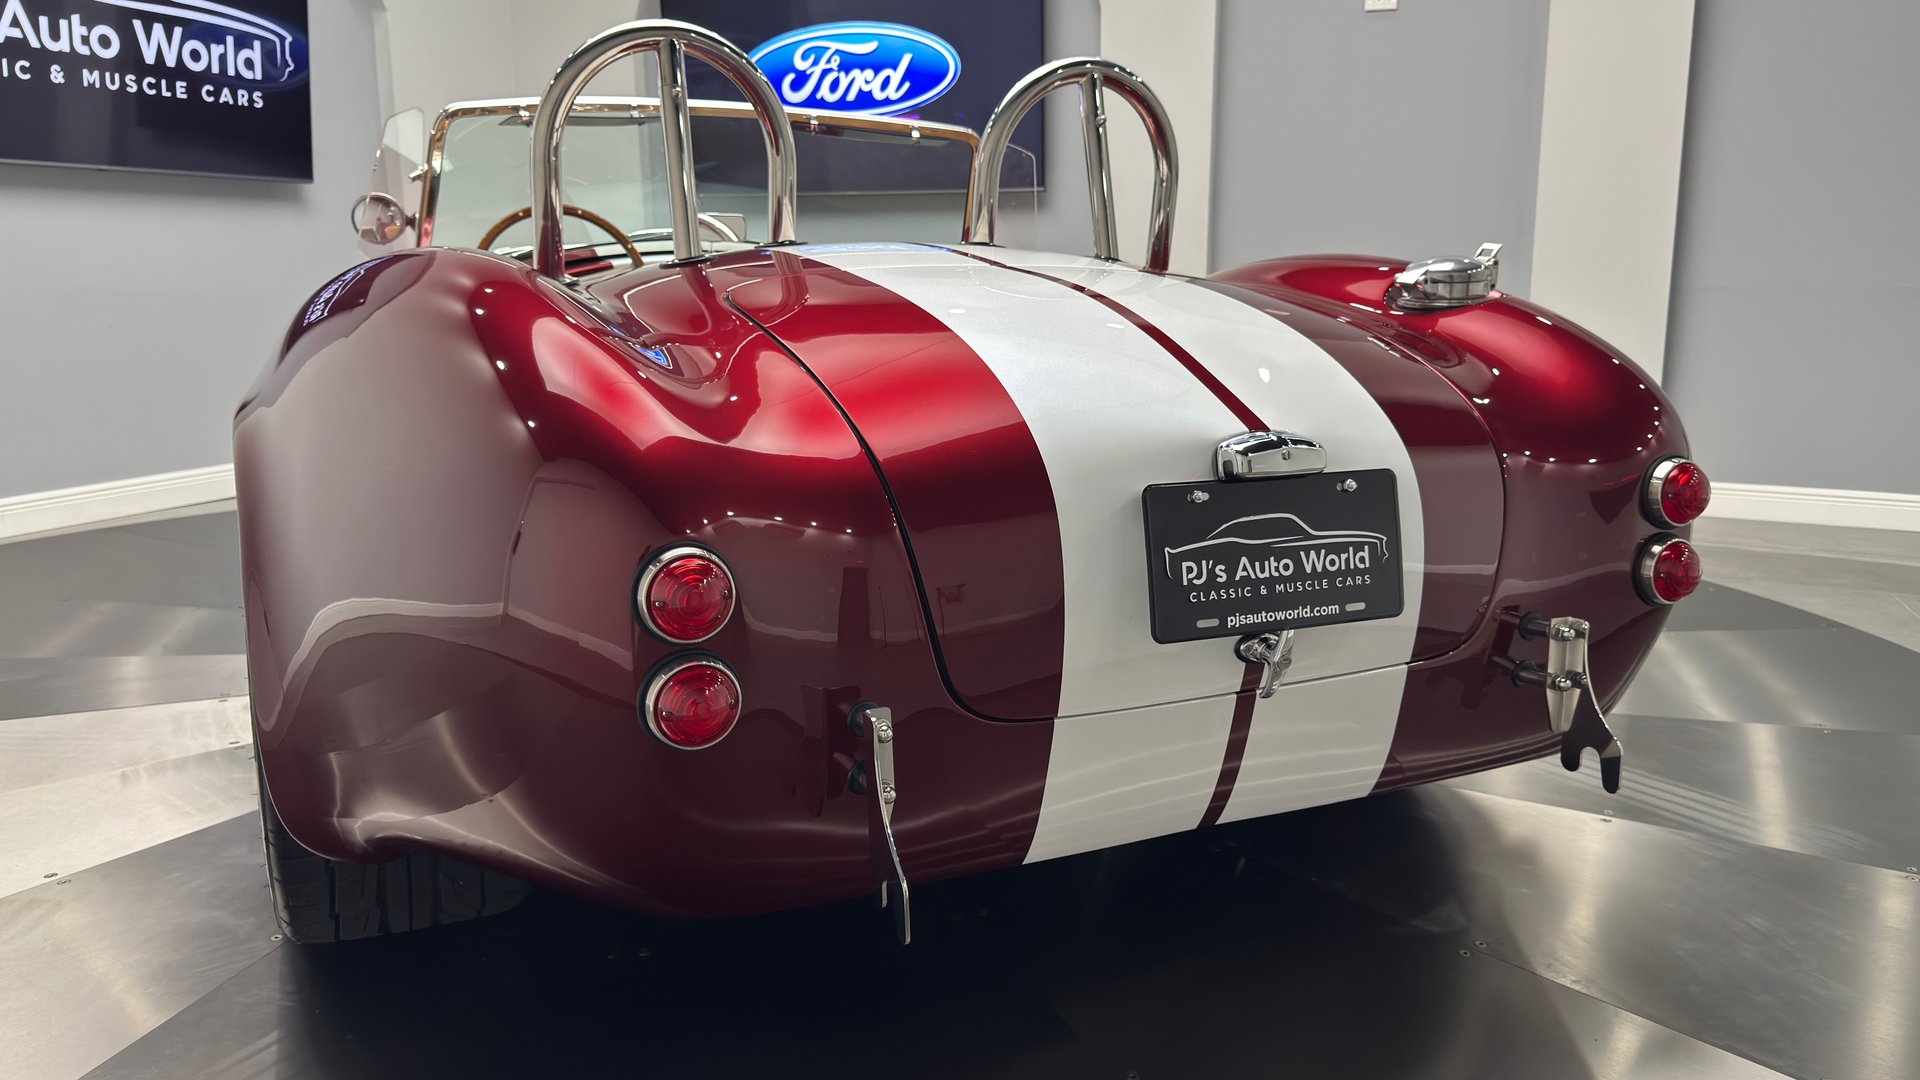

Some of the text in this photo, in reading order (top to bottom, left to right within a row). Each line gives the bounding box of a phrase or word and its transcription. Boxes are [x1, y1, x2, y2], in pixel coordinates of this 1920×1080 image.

[0, 0, 263, 80] Auto World
[49, 64, 65, 84] &
[82, 68, 188, 99] MUSCLE
[201, 84, 265, 109] CARS
[781, 40, 913, 104] Ford
[1181, 545, 1370, 586] PJ's Auto World
[1189, 574, 1372, 603] CLASSIC & MUSCLE CARS
[1227, 603, 1340, 628] pjsautoworld.com
